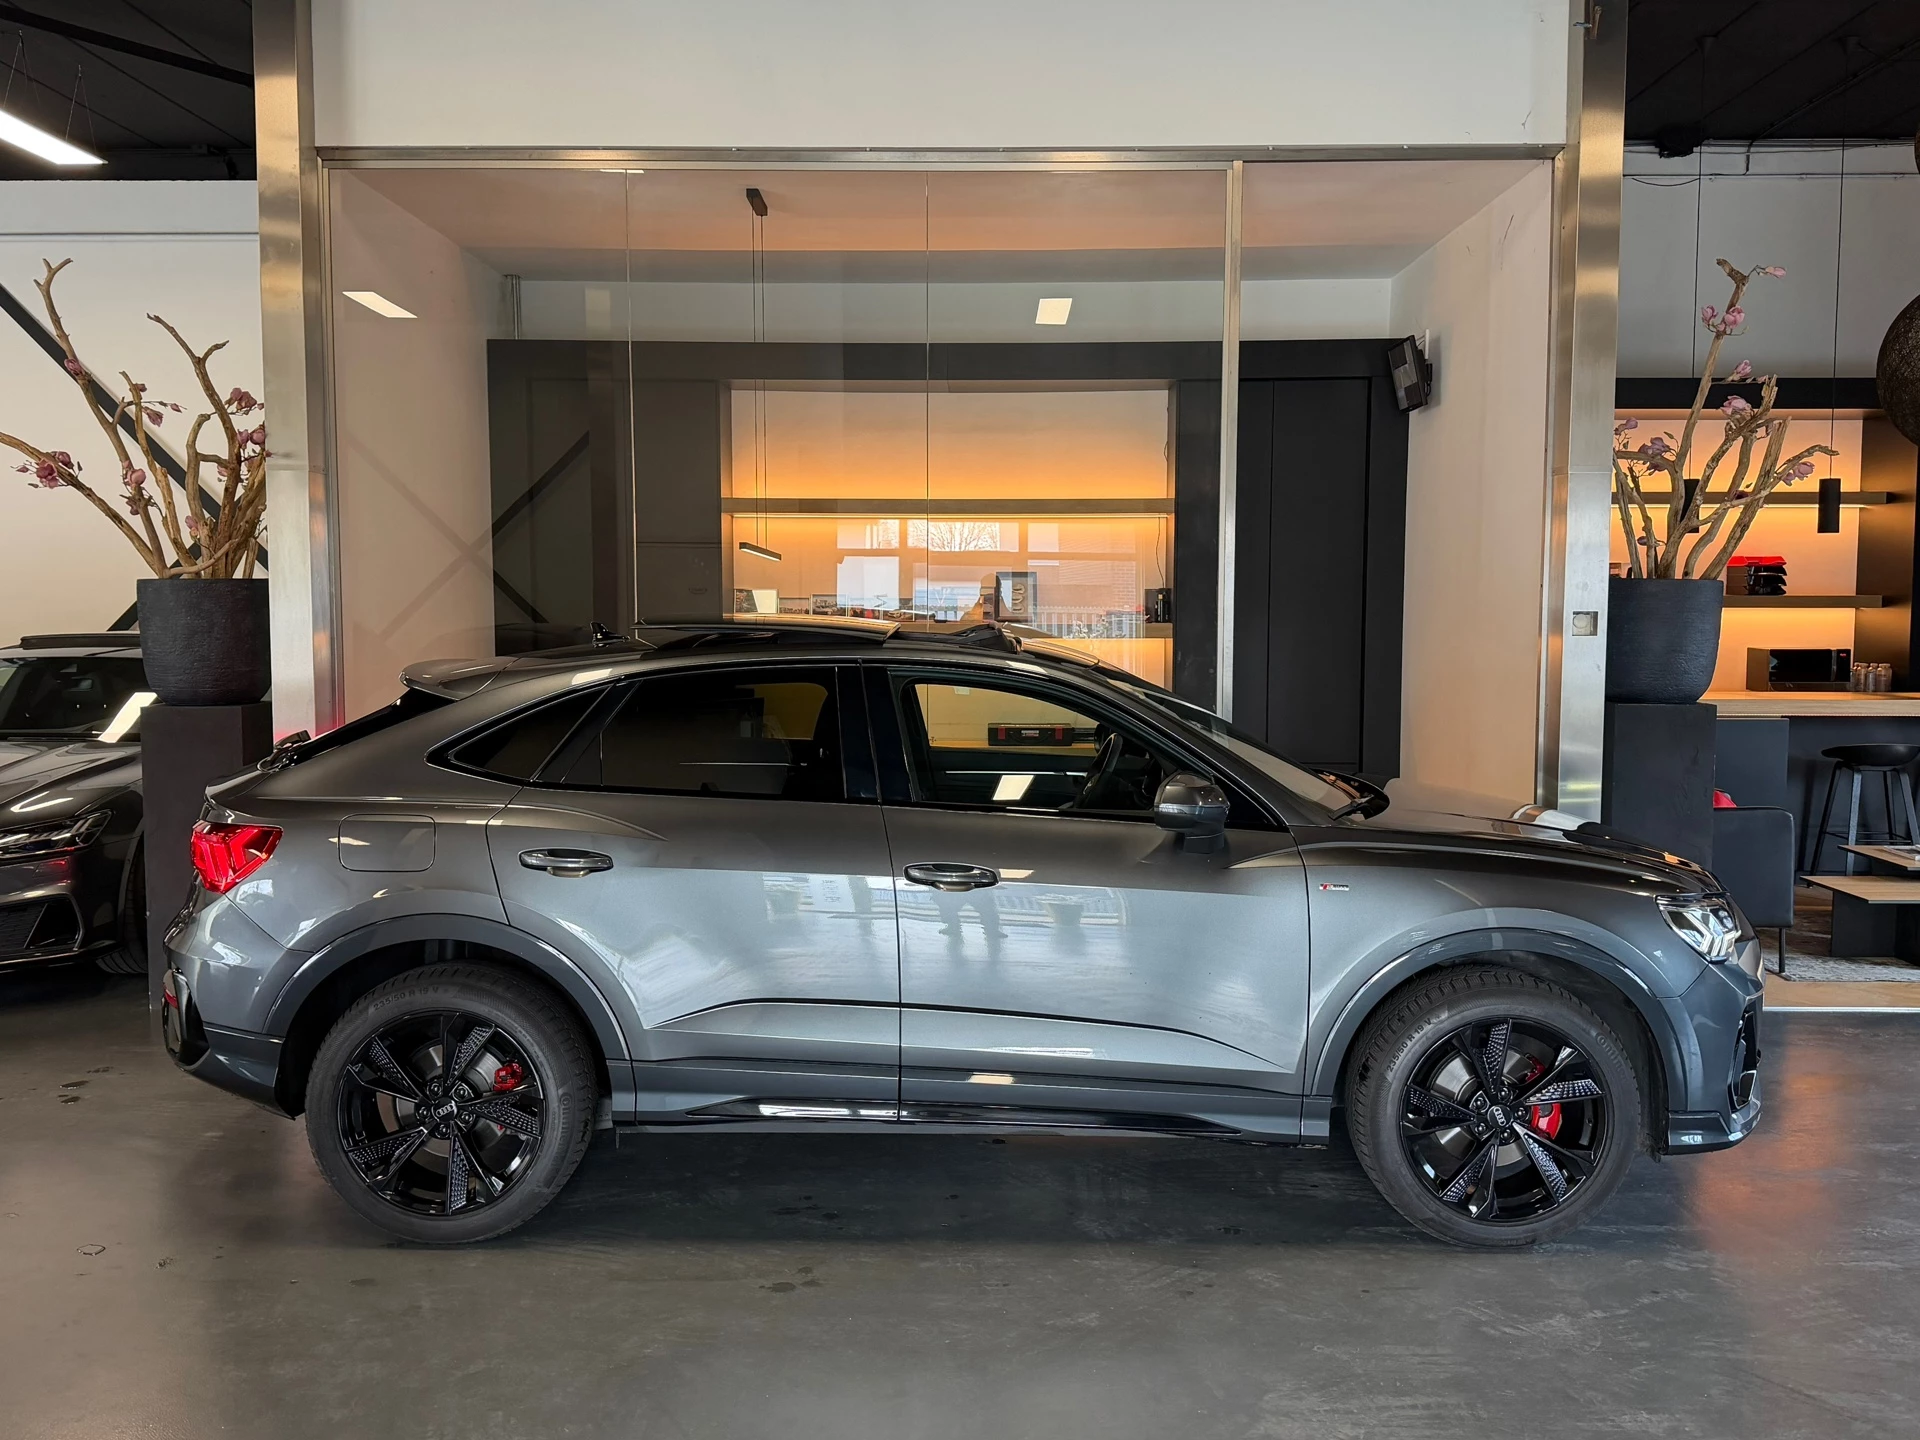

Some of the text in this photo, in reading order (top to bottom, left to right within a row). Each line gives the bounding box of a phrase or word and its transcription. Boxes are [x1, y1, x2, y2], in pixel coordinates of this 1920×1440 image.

[373, 992, 406, 1011] 235/50
[408, 989, 417, 999] R
[432, 986, 440, 995] V
[1387, 1016, 1432, 1074] 235/50 R 19 V
